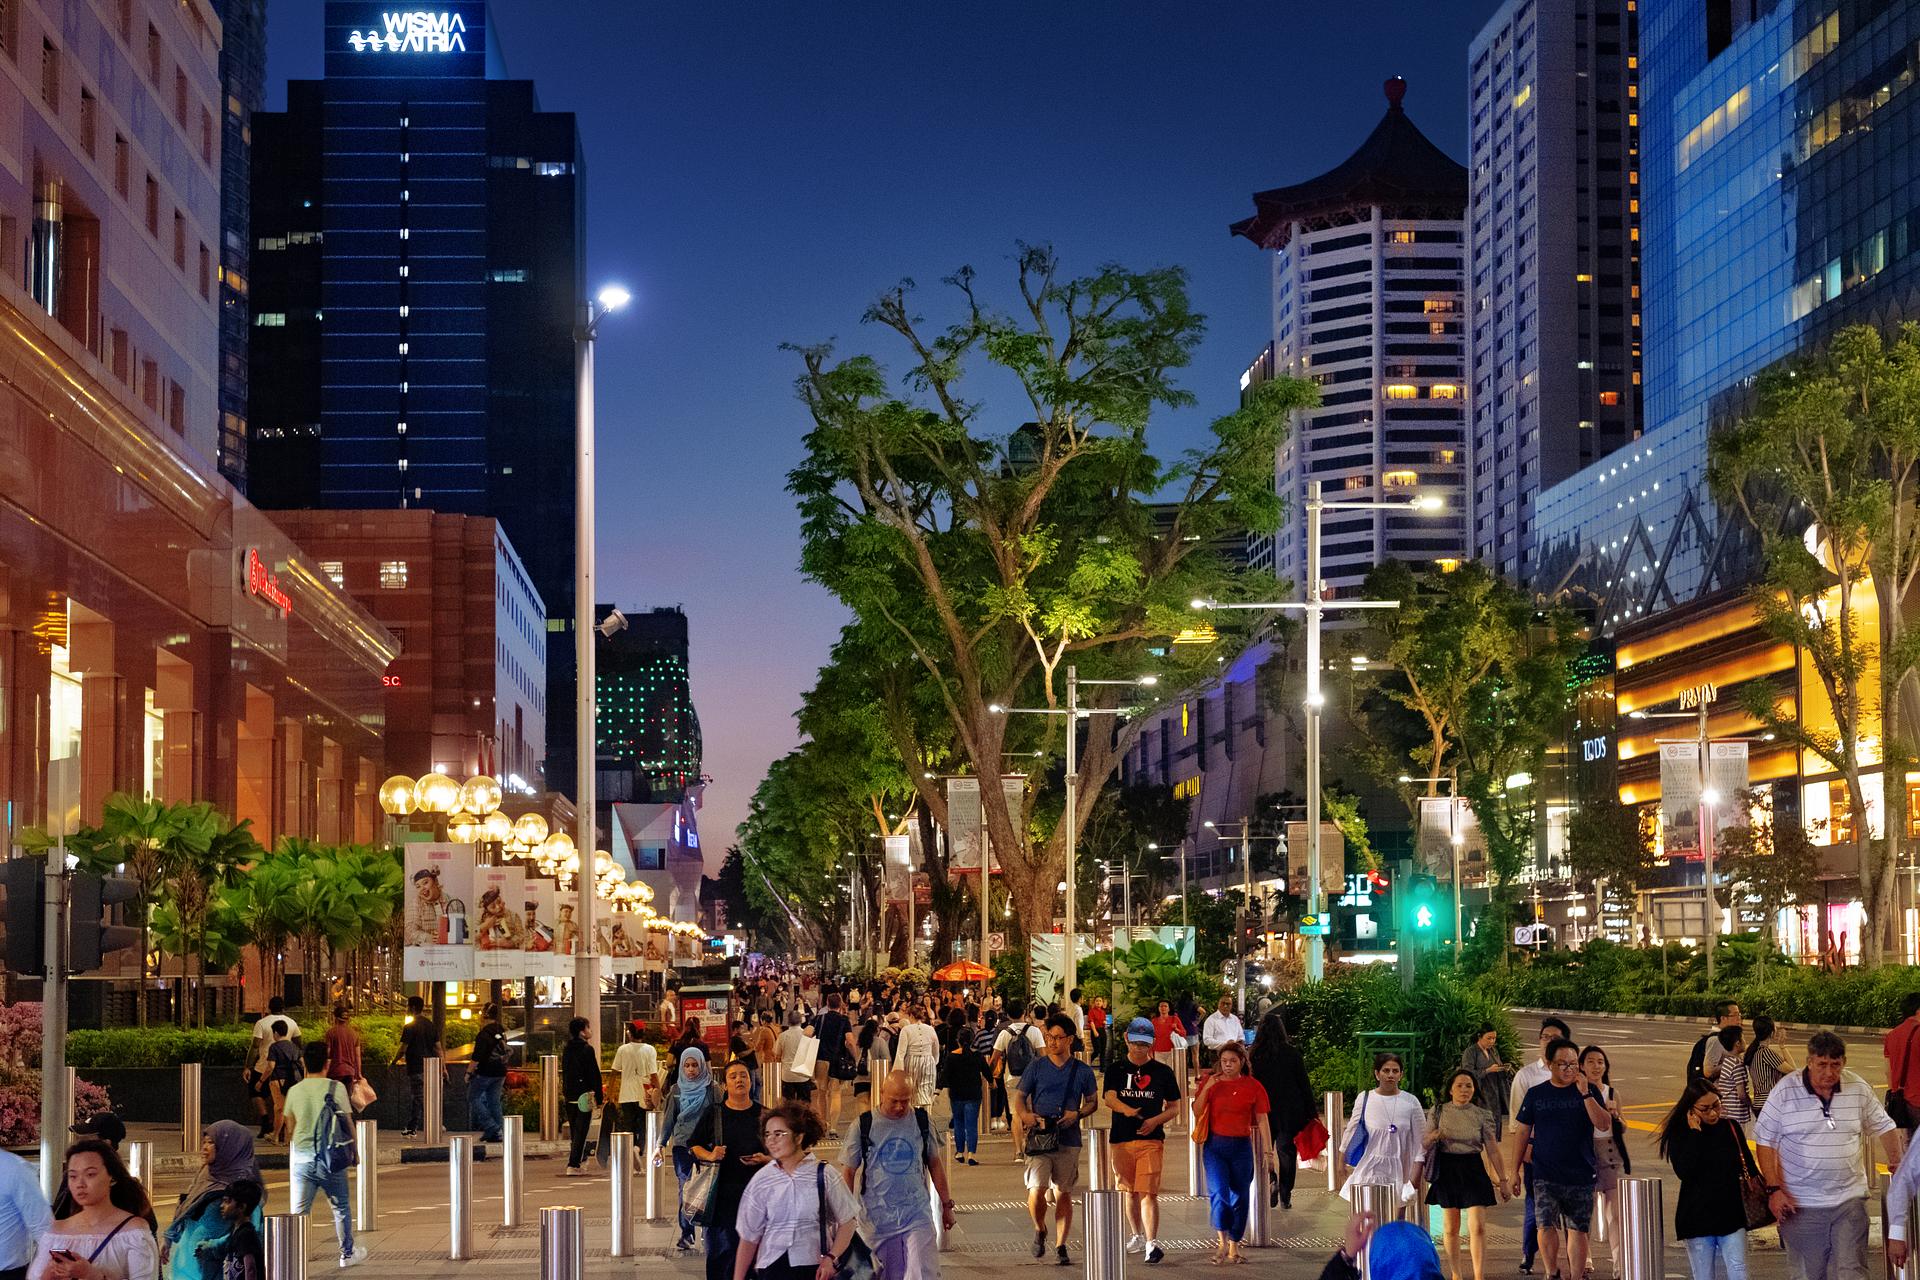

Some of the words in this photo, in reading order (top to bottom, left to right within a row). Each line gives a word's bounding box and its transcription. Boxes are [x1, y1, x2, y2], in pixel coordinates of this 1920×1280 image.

[383, 12, 466, 32] WISMA
[401, 32, 466, 52] ATRIA
[1679, 683, 1718, 710] PRADA
[1125, 1073, 1133, 1090] I
[1120, 1090, 1155, 1099] SINGAPORE
